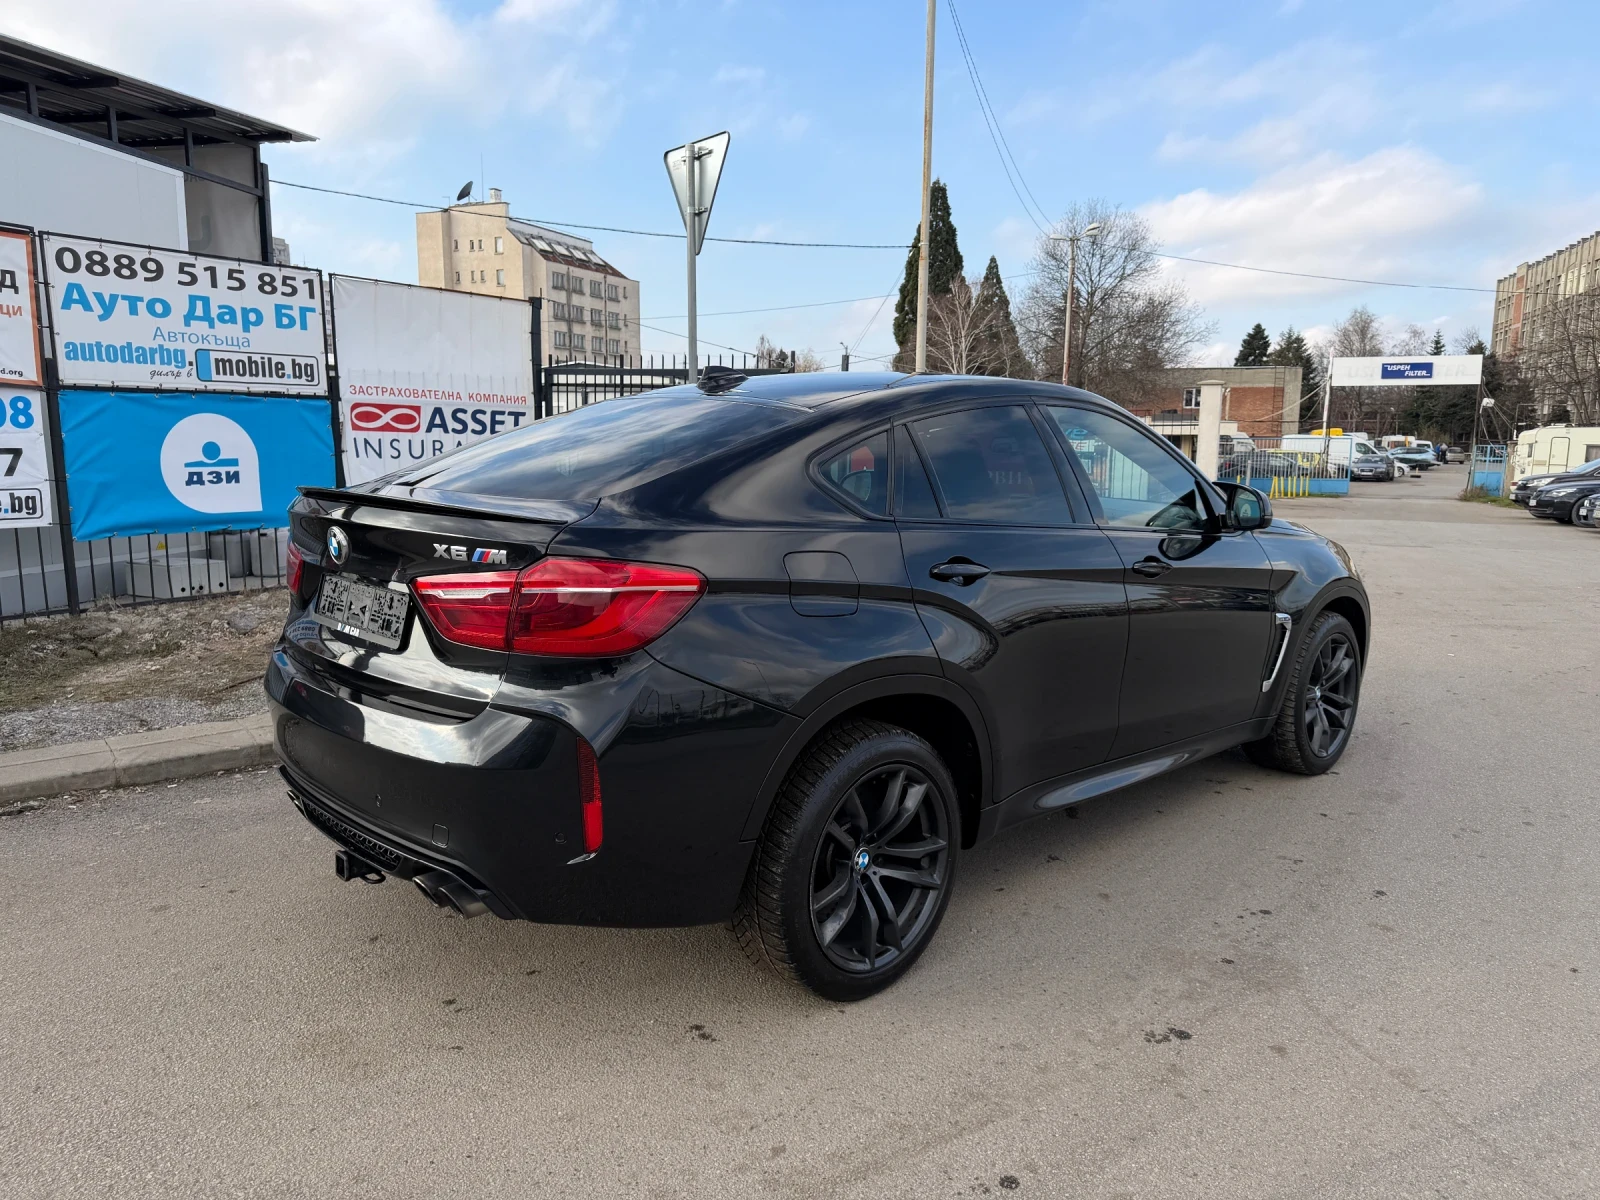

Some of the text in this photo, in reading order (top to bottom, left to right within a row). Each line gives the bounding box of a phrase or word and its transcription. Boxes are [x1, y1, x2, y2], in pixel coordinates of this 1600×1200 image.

[55, 246, 315, 299] 0889 515 851
[60, 282, 316, 333] Ауто Дар БГ
[152, 326, 251, 350] Автокъща
[214, 356, 315, 382] mobile.bg
[349, 384, 527, 405] ЗАСТРАХОВАТЕЛНА КОМПАНИЯ
[0, 396, 35, 429] 8
[425, 406, 526, 435] ASSET
[185, 470, 240, 486] ДЗИ
[432, 543, 468, 561] X6
